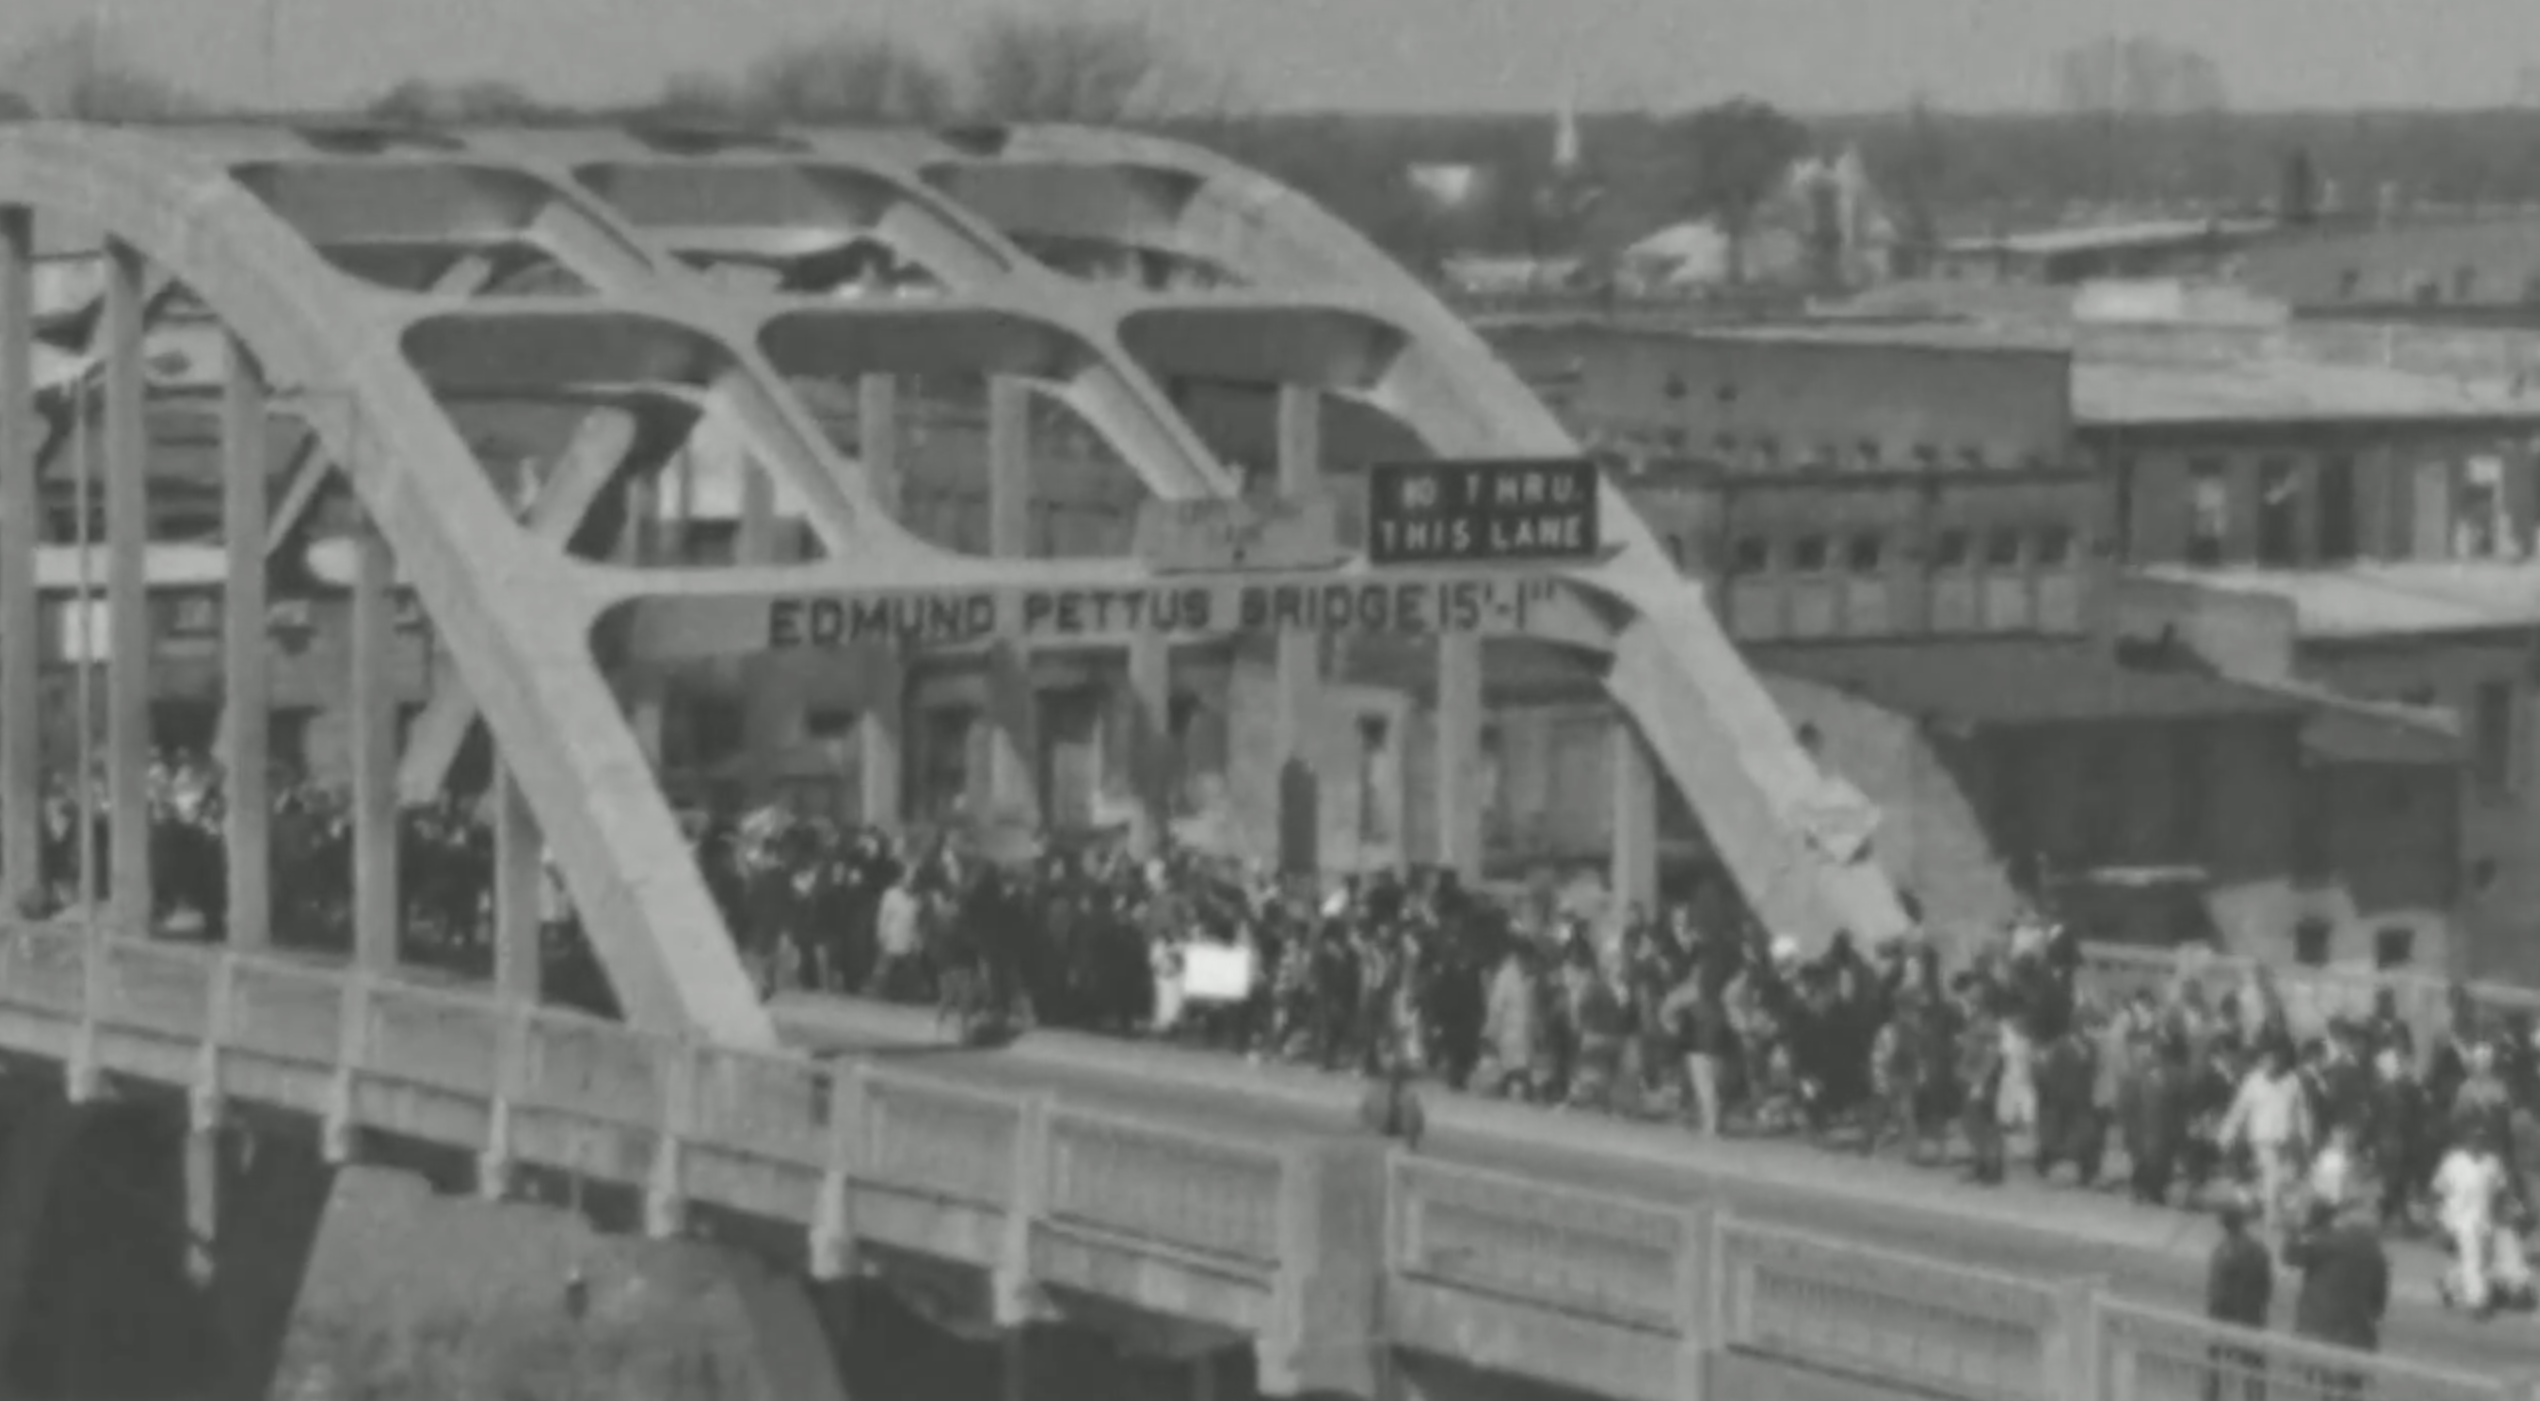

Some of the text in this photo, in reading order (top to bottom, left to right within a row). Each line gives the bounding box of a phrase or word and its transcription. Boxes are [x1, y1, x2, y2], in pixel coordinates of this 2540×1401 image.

[1382, 515, 1582, 552] THIS LANE
[769, 595, 994, 649] EDMUND
[1024, 589, 1210, 633] PETTUS
[1239, 583, 1427, 633] BRIDGE
